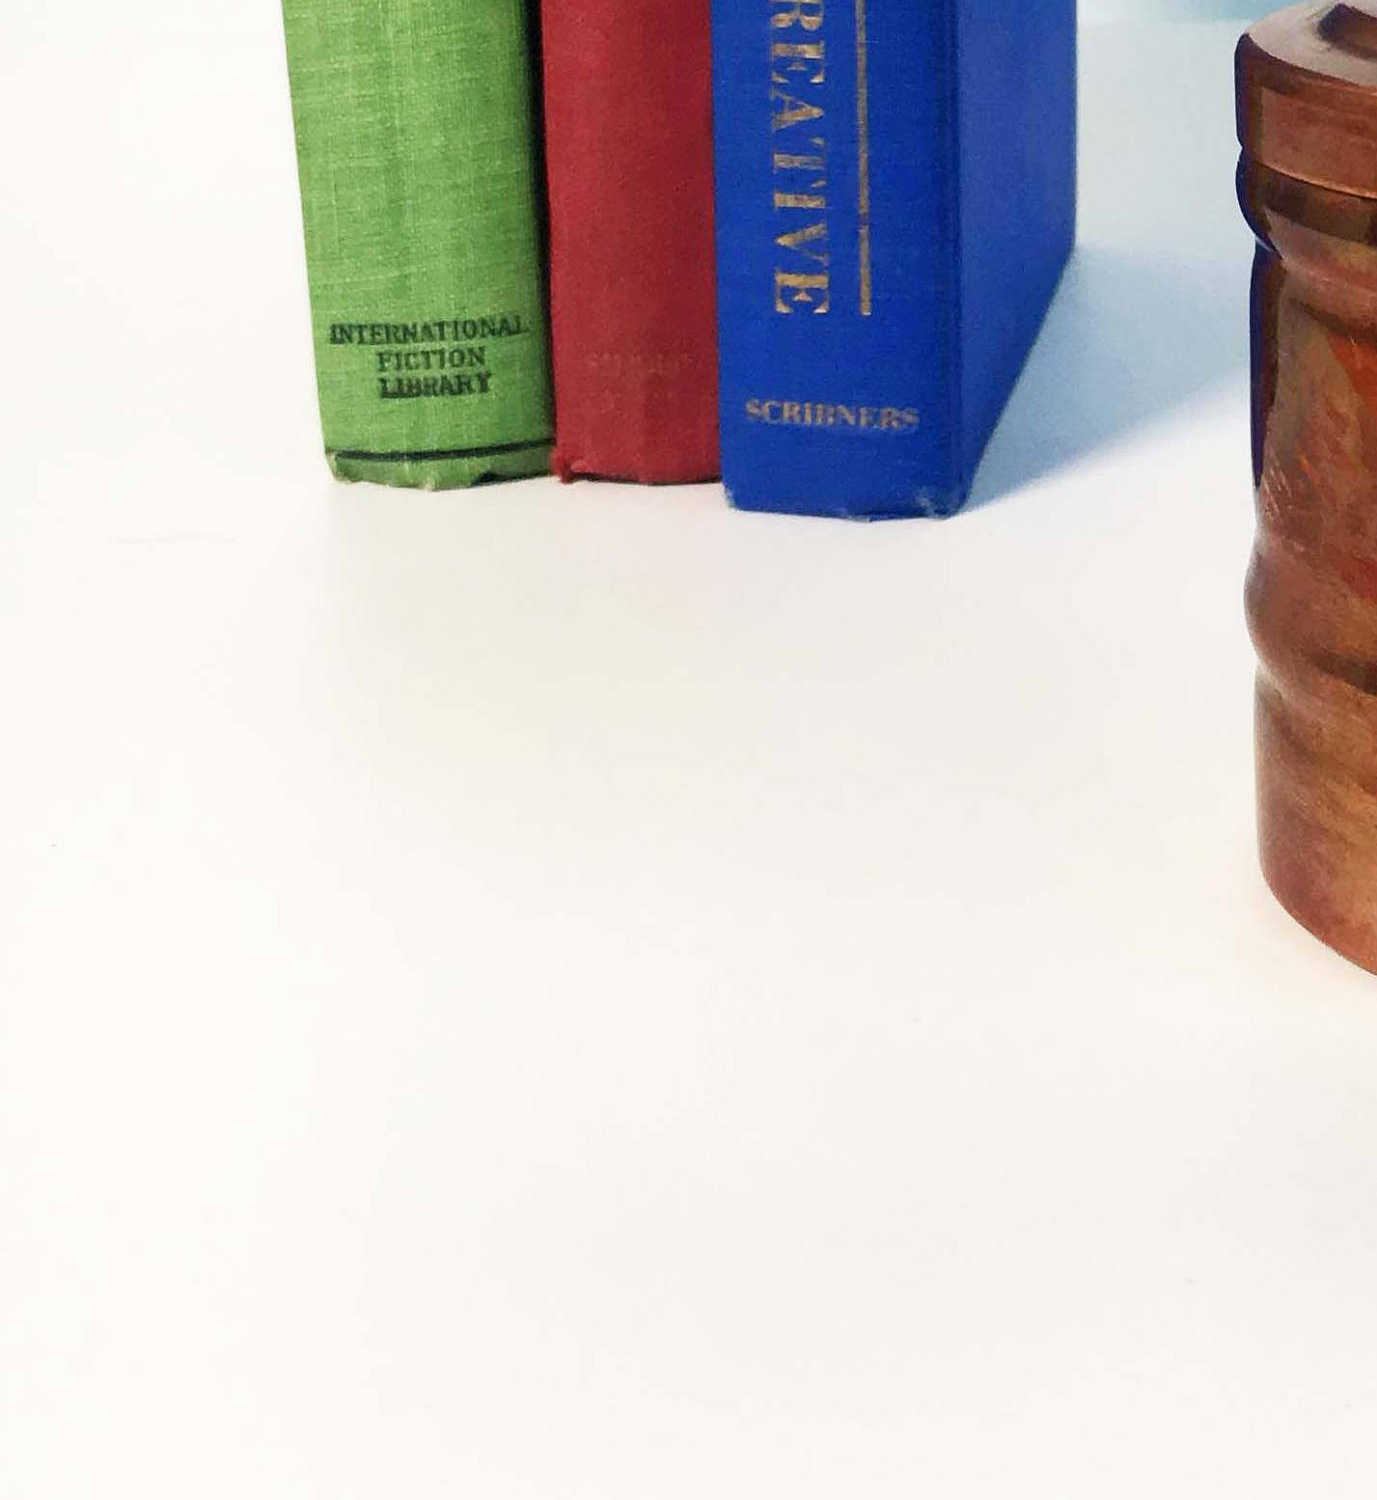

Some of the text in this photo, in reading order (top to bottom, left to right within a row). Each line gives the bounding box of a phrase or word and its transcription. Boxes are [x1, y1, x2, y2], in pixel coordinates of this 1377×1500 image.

[328, 313, 529, 346] INTERNATIONAL
[376, 346, 487, 373] FICTION
[377, 371, 493, 399] LIBRARY
[744, 398, 921, 430] SCRIBNERS
